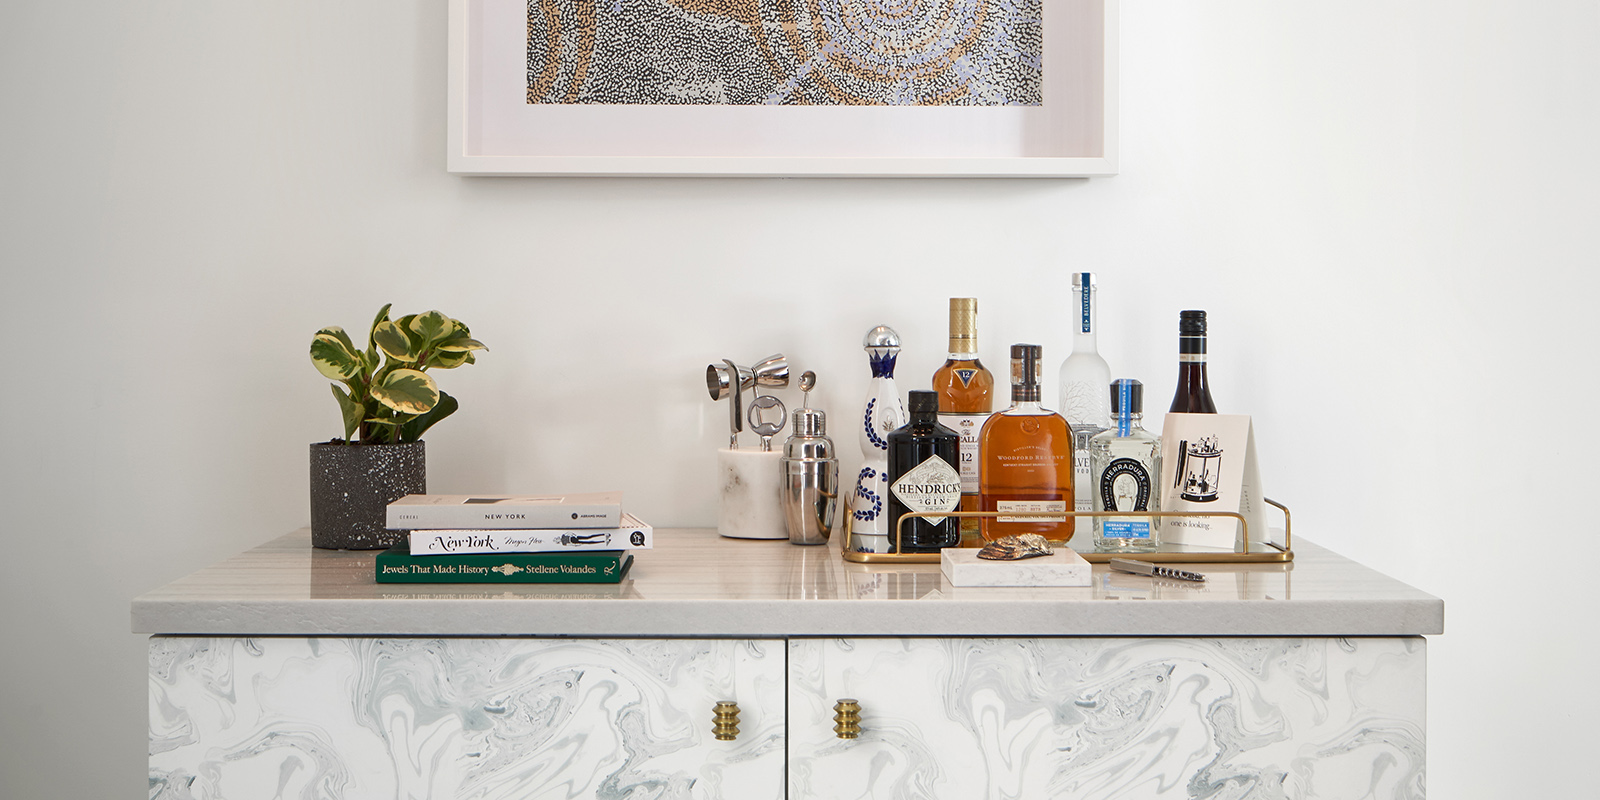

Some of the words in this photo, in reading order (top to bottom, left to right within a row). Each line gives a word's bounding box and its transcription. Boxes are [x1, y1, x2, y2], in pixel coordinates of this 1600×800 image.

[961, 453, 972, 462] 12
[1105, 463, 1146, 481] HERRADURA
[924, 498, 945, 506] GIN
[382, 564, 409, 574] Jewels
[409, 564, 431, 574] That
[432, 564, 455, 574] Made
[458, 564, 490, 576] History
[525, 564, 558, 574] Stellene
[559, 564, 597, 574] Volandes
